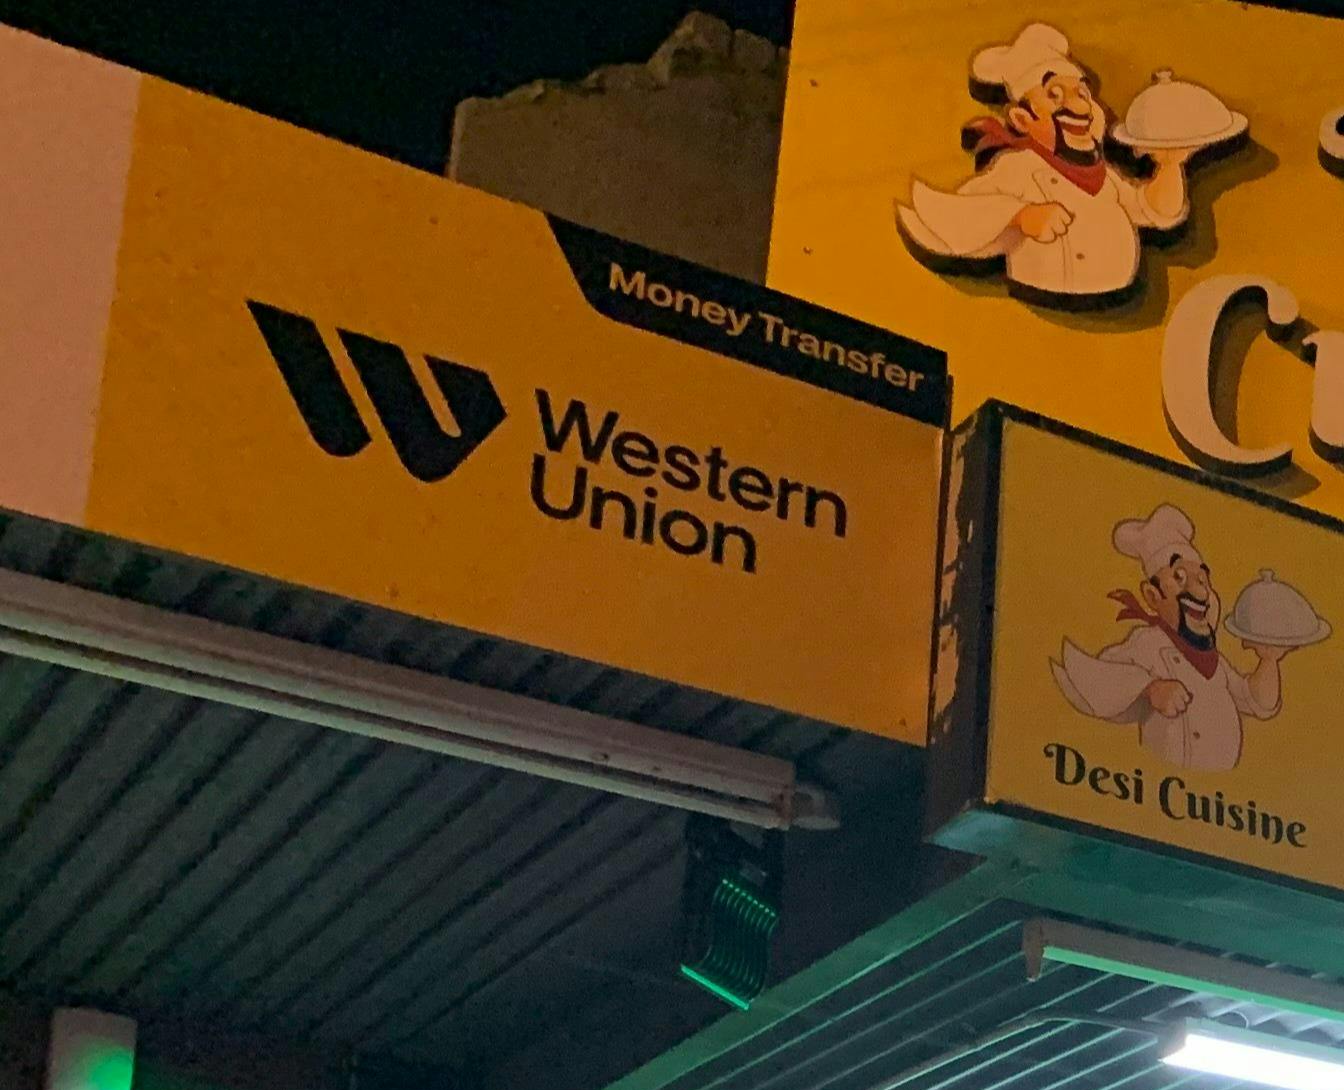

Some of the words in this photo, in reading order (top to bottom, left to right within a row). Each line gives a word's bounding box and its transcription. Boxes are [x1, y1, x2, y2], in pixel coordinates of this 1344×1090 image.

[608, 261, 753, 337] Money
[758, 311, 926, 394] Transfer
[529, 452, 759, 575] Union
[533, 386, 849, 538] Western
[1043, 741, 1145, 805] Desi
[1157, 775, 1308, 849] Cuisine
